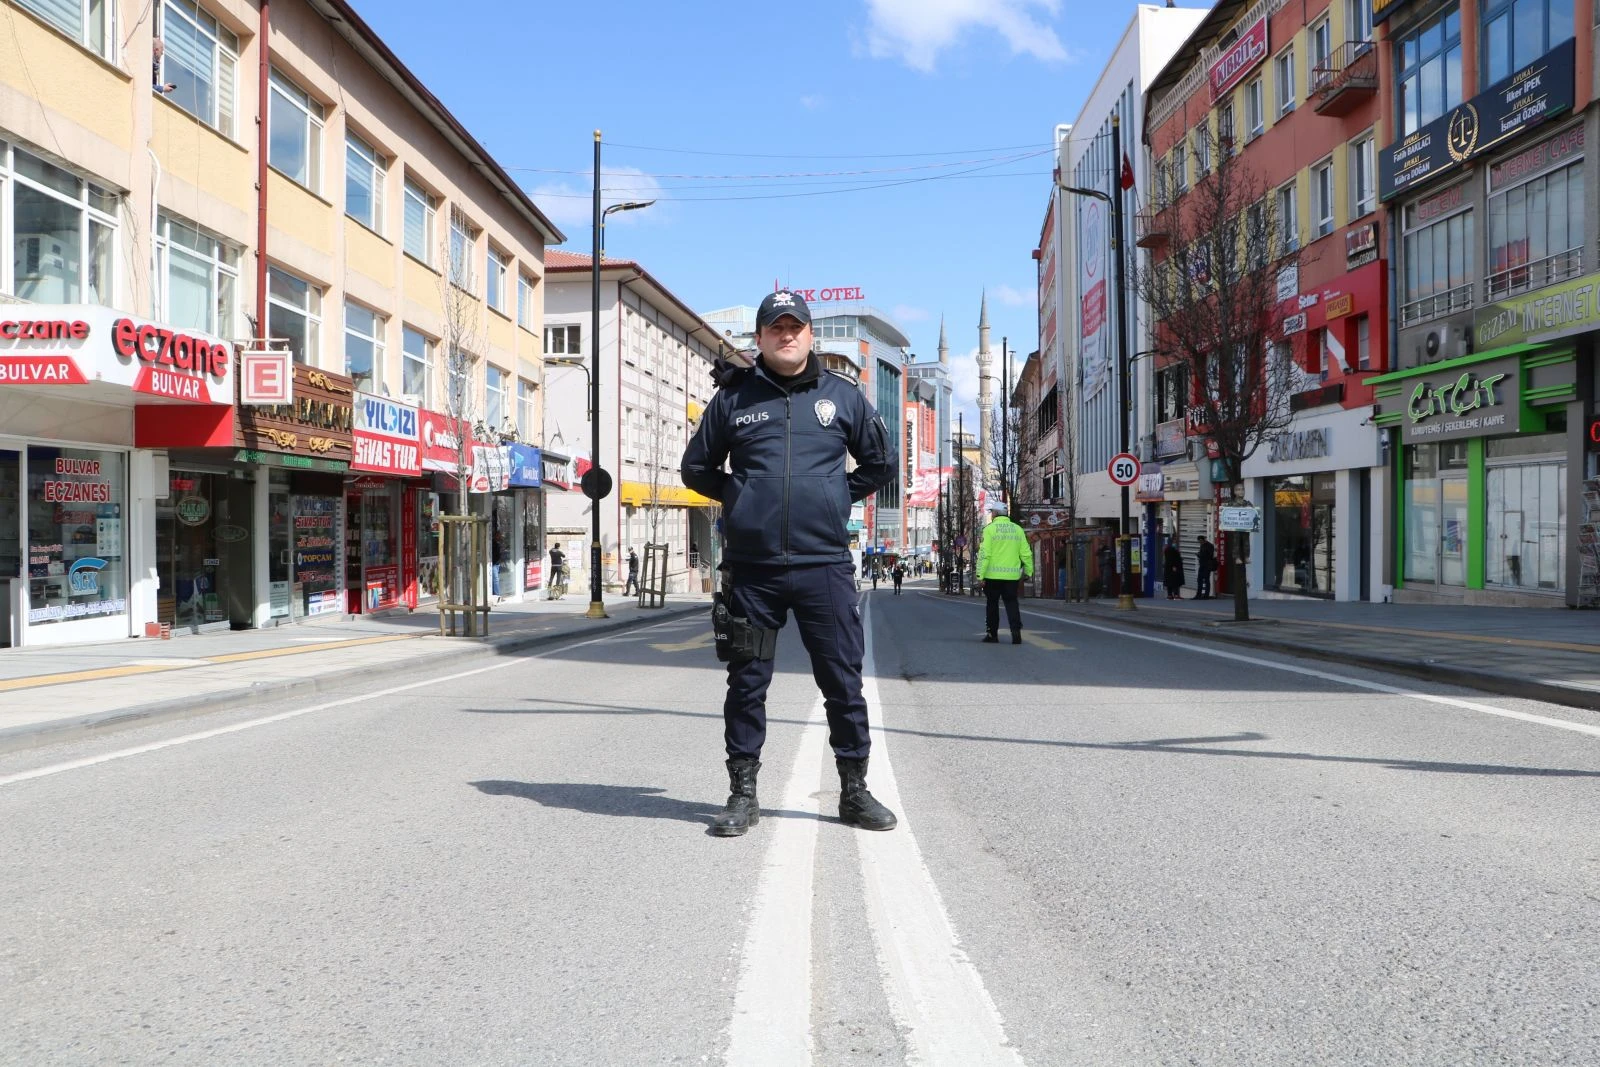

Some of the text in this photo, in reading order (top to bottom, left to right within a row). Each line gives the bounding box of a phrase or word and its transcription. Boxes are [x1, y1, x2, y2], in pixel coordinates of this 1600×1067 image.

[1513, 66, 1534, 84] AVUKAT
[1513, 93, 1534, 110] AVUKAT
[820, 287, 865, 300] OTEL
[113, 318, 228, 377] eczane
[0, 363, 69, 380] BULVAR
[254, 364, 277, 393] E
[152, 370, 200, 398] BULVAR
[1483, 414, 1505, 427] KAHVE
[56, 457, 100, 475] BULVAR
[1116, 463, 1133, 478] 50
